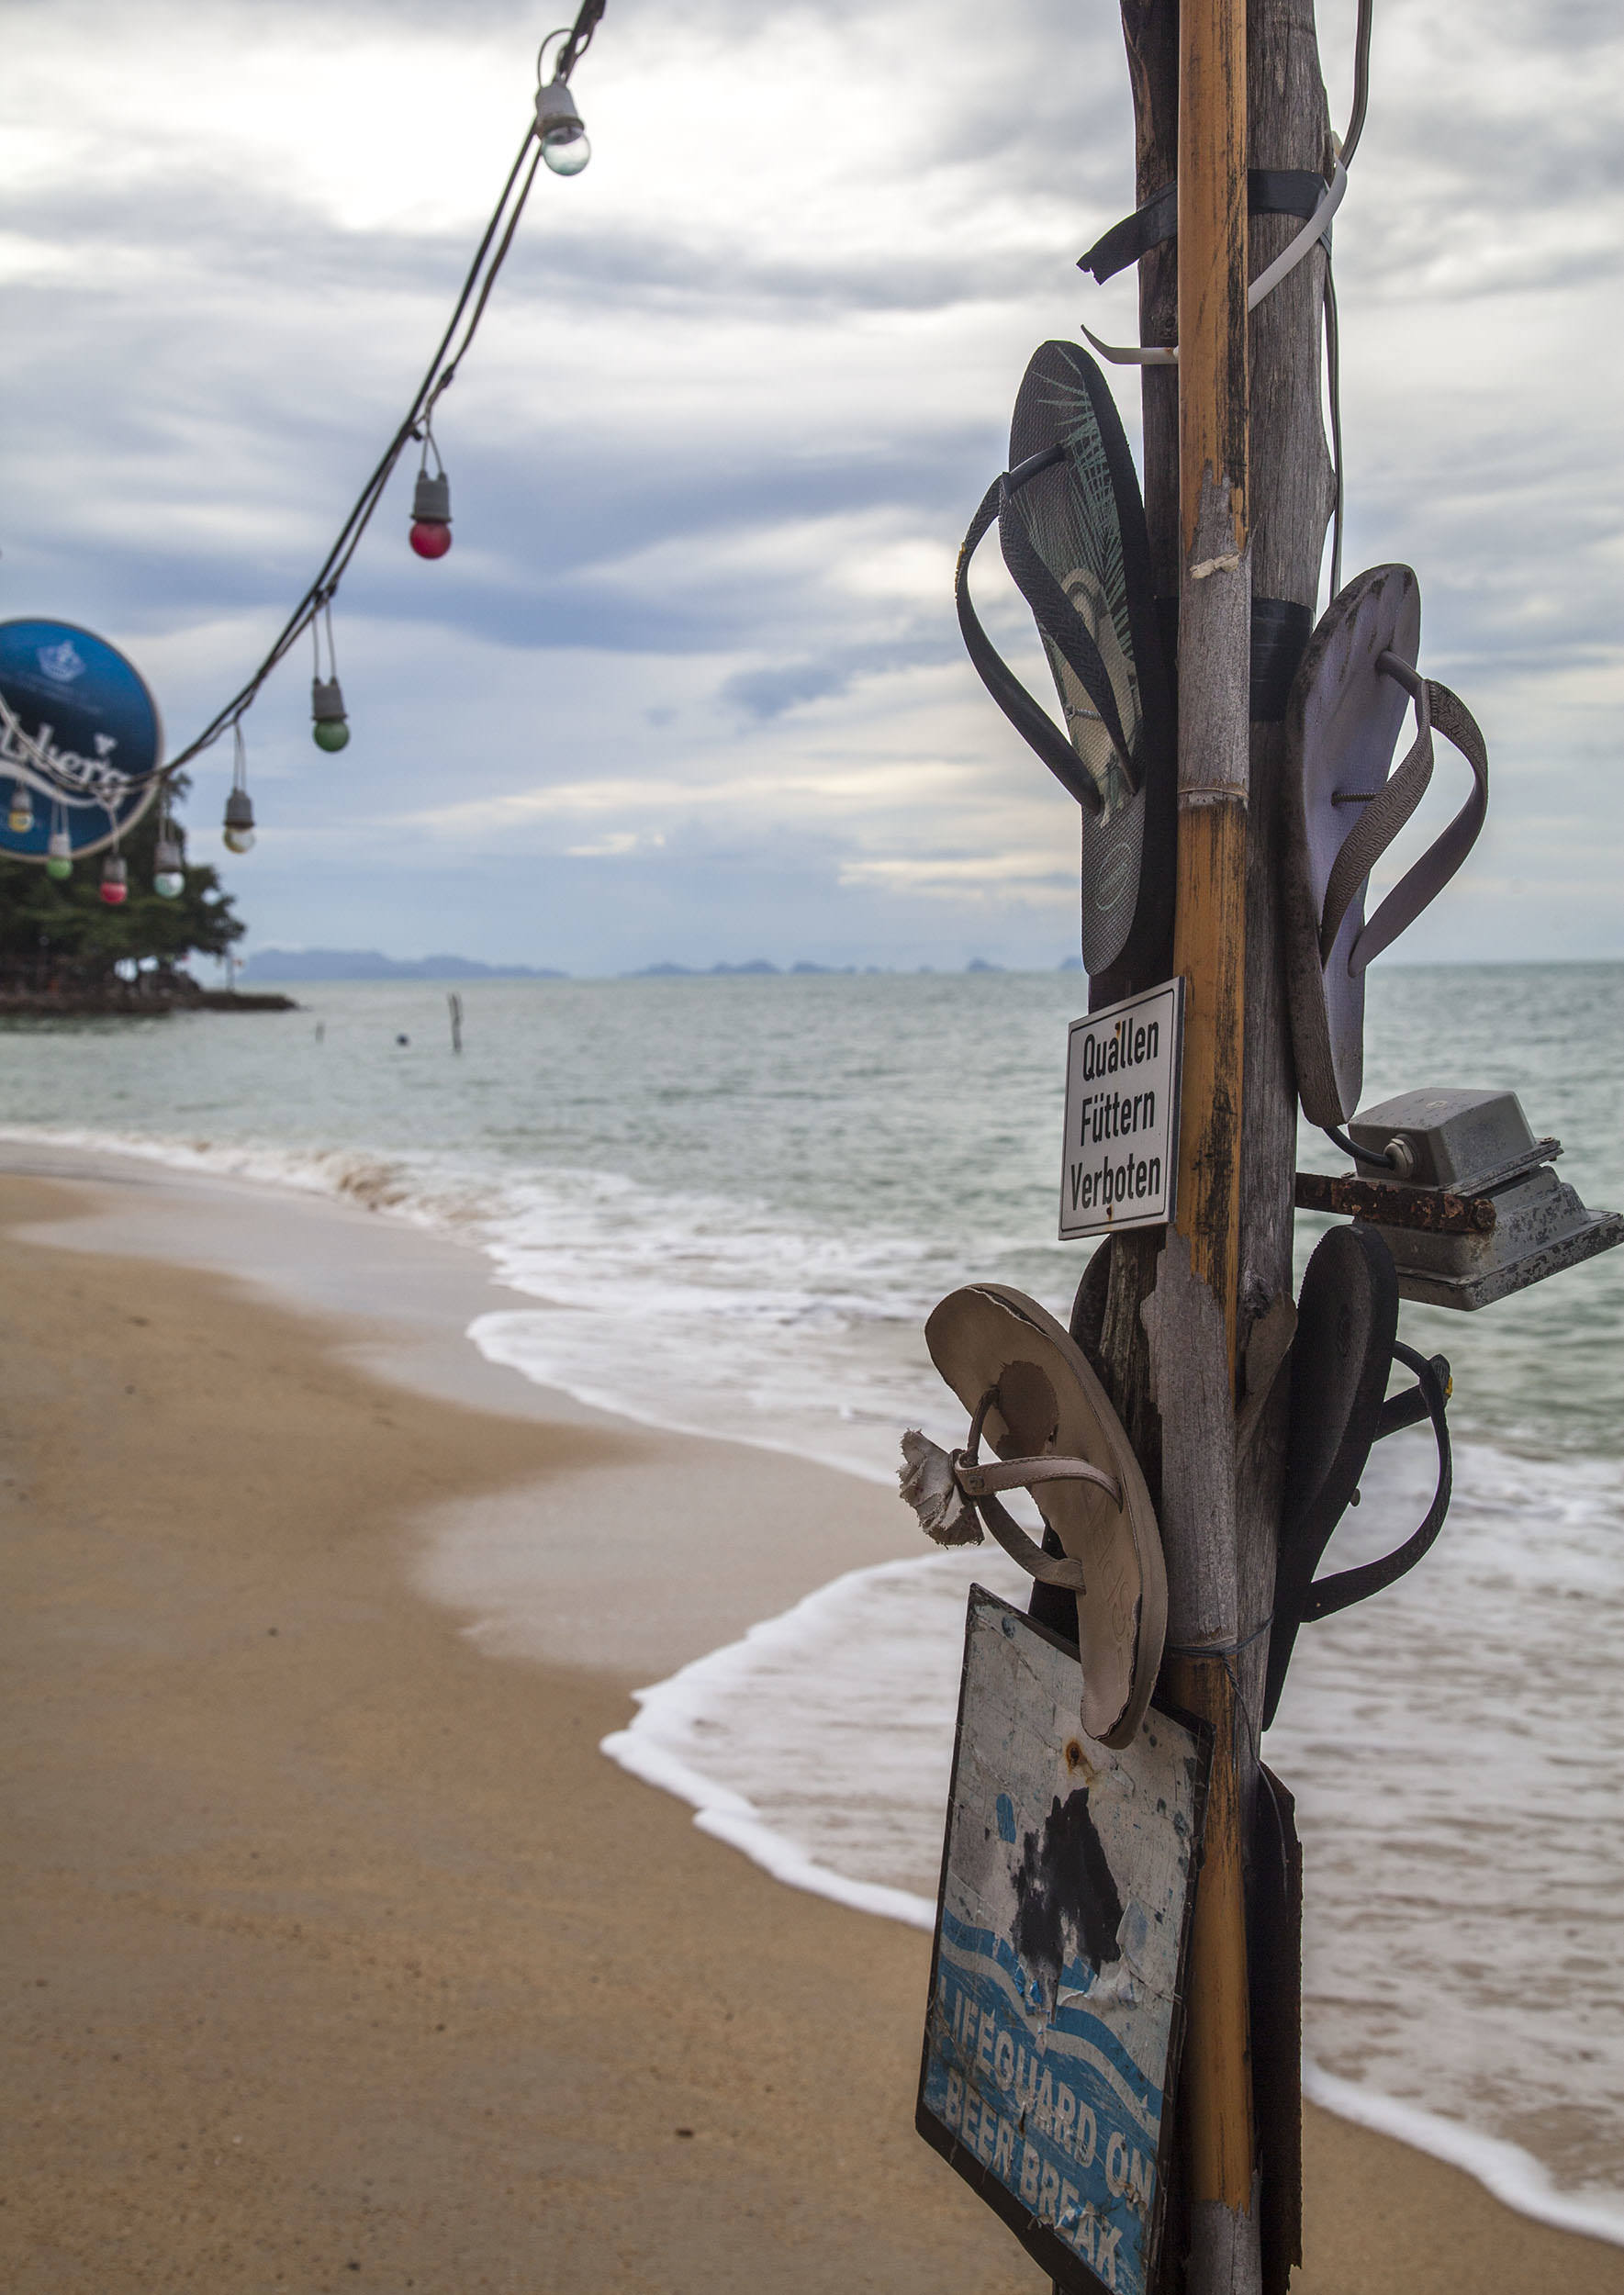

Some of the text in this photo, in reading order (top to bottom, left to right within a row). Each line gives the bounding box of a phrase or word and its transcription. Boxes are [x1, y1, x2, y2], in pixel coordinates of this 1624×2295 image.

[1082, 1017, 1159, 1081] Quallen
[1080, 1090, 1155, 1147] Füttern
[1070, 1153, 1161, 1211] Verboten
[945, 2067, 1124, 2290] BEER BREAK
[1104, 2131, 1156, 2220] ON
